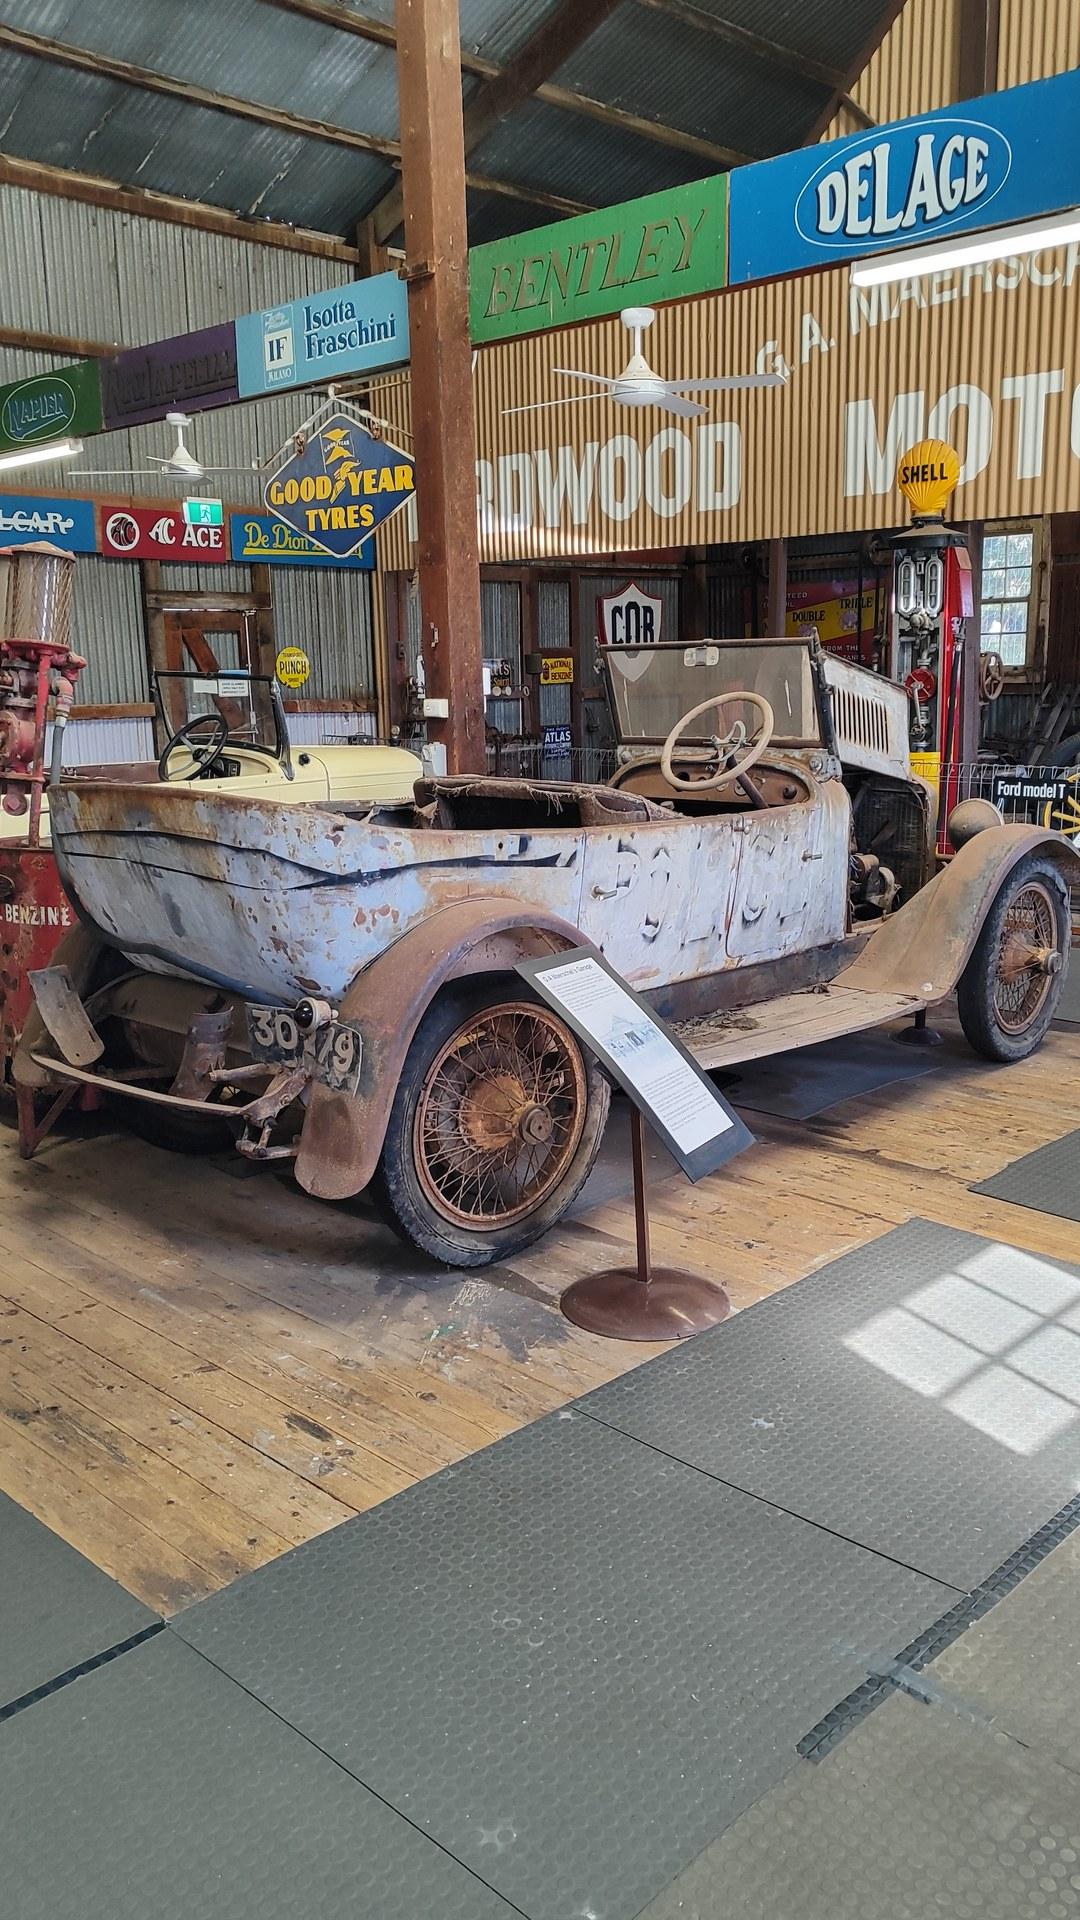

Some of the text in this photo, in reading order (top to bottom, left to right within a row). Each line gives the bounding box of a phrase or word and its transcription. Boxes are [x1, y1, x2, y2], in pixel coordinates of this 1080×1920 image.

[818, 134, 989, 235] DELAGE
[483, 208, 708, 318] BENTLEY
[303, 300, 356, 333] Isotta
[268, 336, 287, 362] IF
[305, 313, 396, 361] Fraschini
[8, 391, 65, 433] NAPIER
[843, 367, 1080, 498] MOT
[270, 465, 414, 505] GOOD YEAR
[475, 421, 742, 535] RDWOOD
[901, 462, 948, 485] SHELL
[149, 517, 223, 548] AC ACE
[306, 503, 374, 532] TYRES
[244, 521, 270, 548] De
[272, 523, 309, 551] Dion
[792, 610, 826, 622] DOUBLE
[280, 660, 307, 675] PUNCH
[545, 730, 571, 743] ATLAS
[997, 780, 1066, 799] Ford model T
[5, 903, 72, 926] BENZINE
